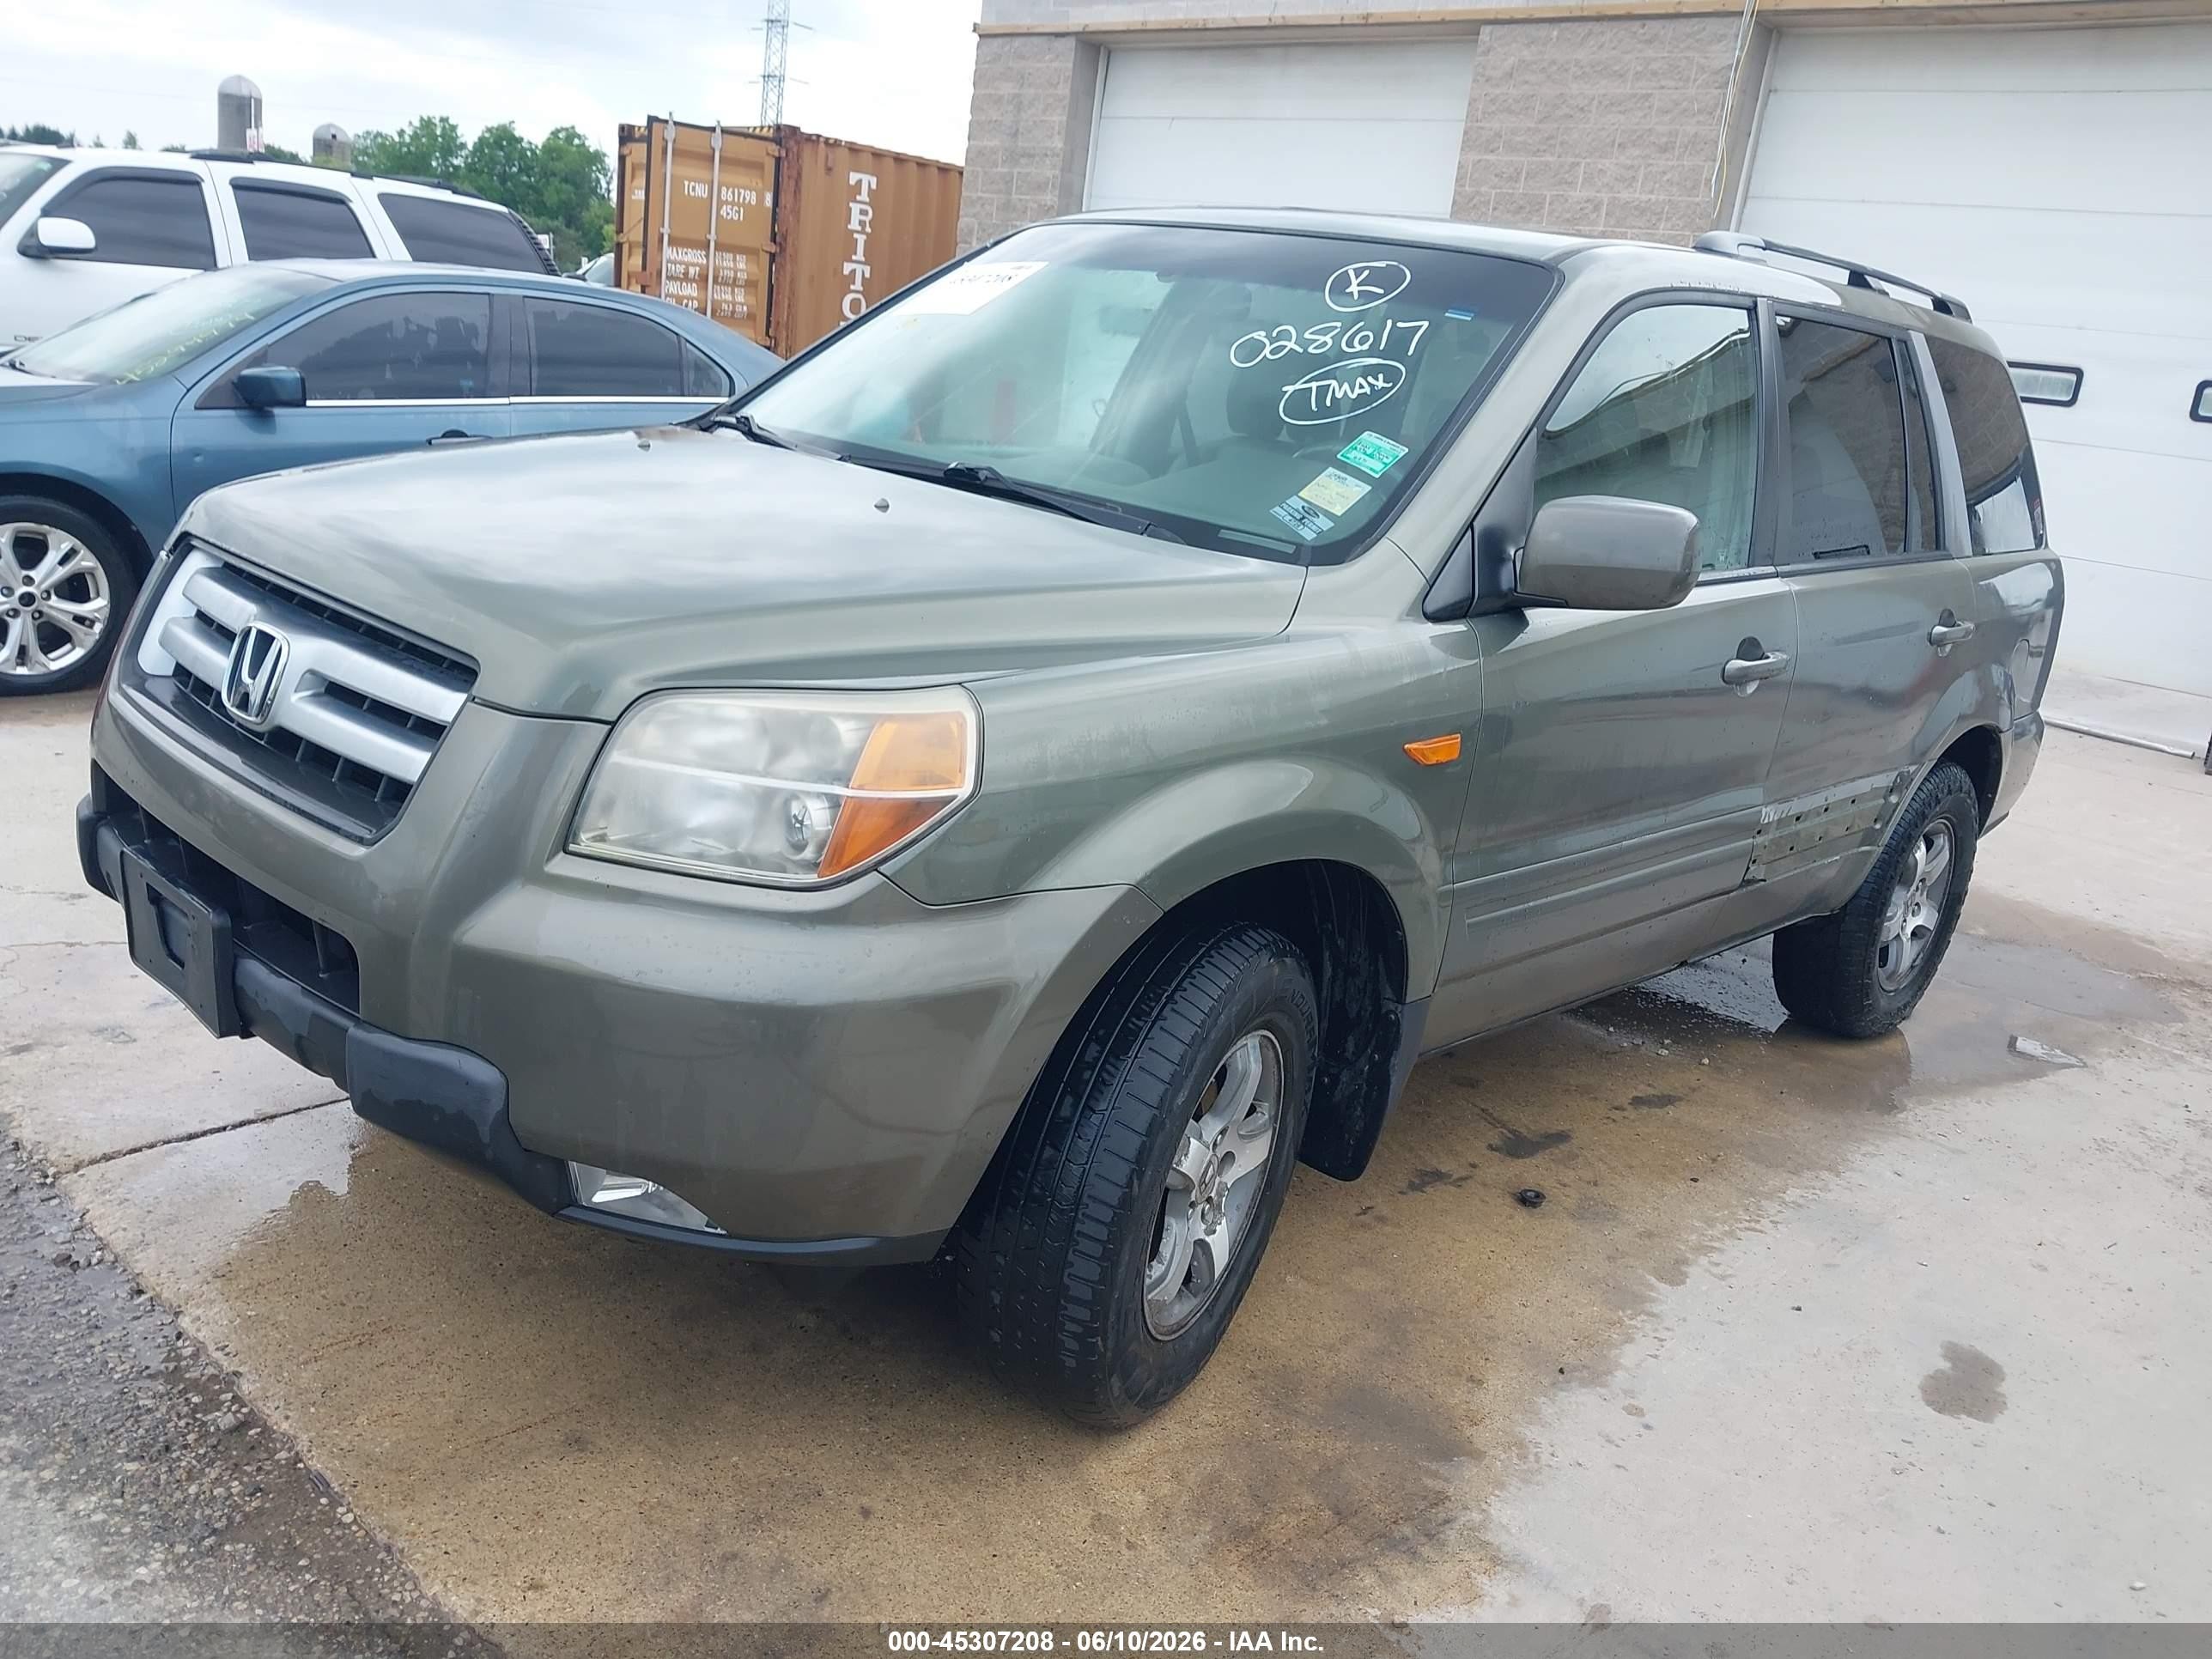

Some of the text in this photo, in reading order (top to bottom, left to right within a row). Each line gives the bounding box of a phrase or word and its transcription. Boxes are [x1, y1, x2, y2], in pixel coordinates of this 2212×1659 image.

[684, 179, 708, 198] TCNU
[720, 186, 757, 206] 861798
[838, 171, 877, 325] TRITO
[1346, 268, 1384, 300] K
[1230, 319, 1430, 368] 028617
[1282, 373, 1393, 411] TMAX
